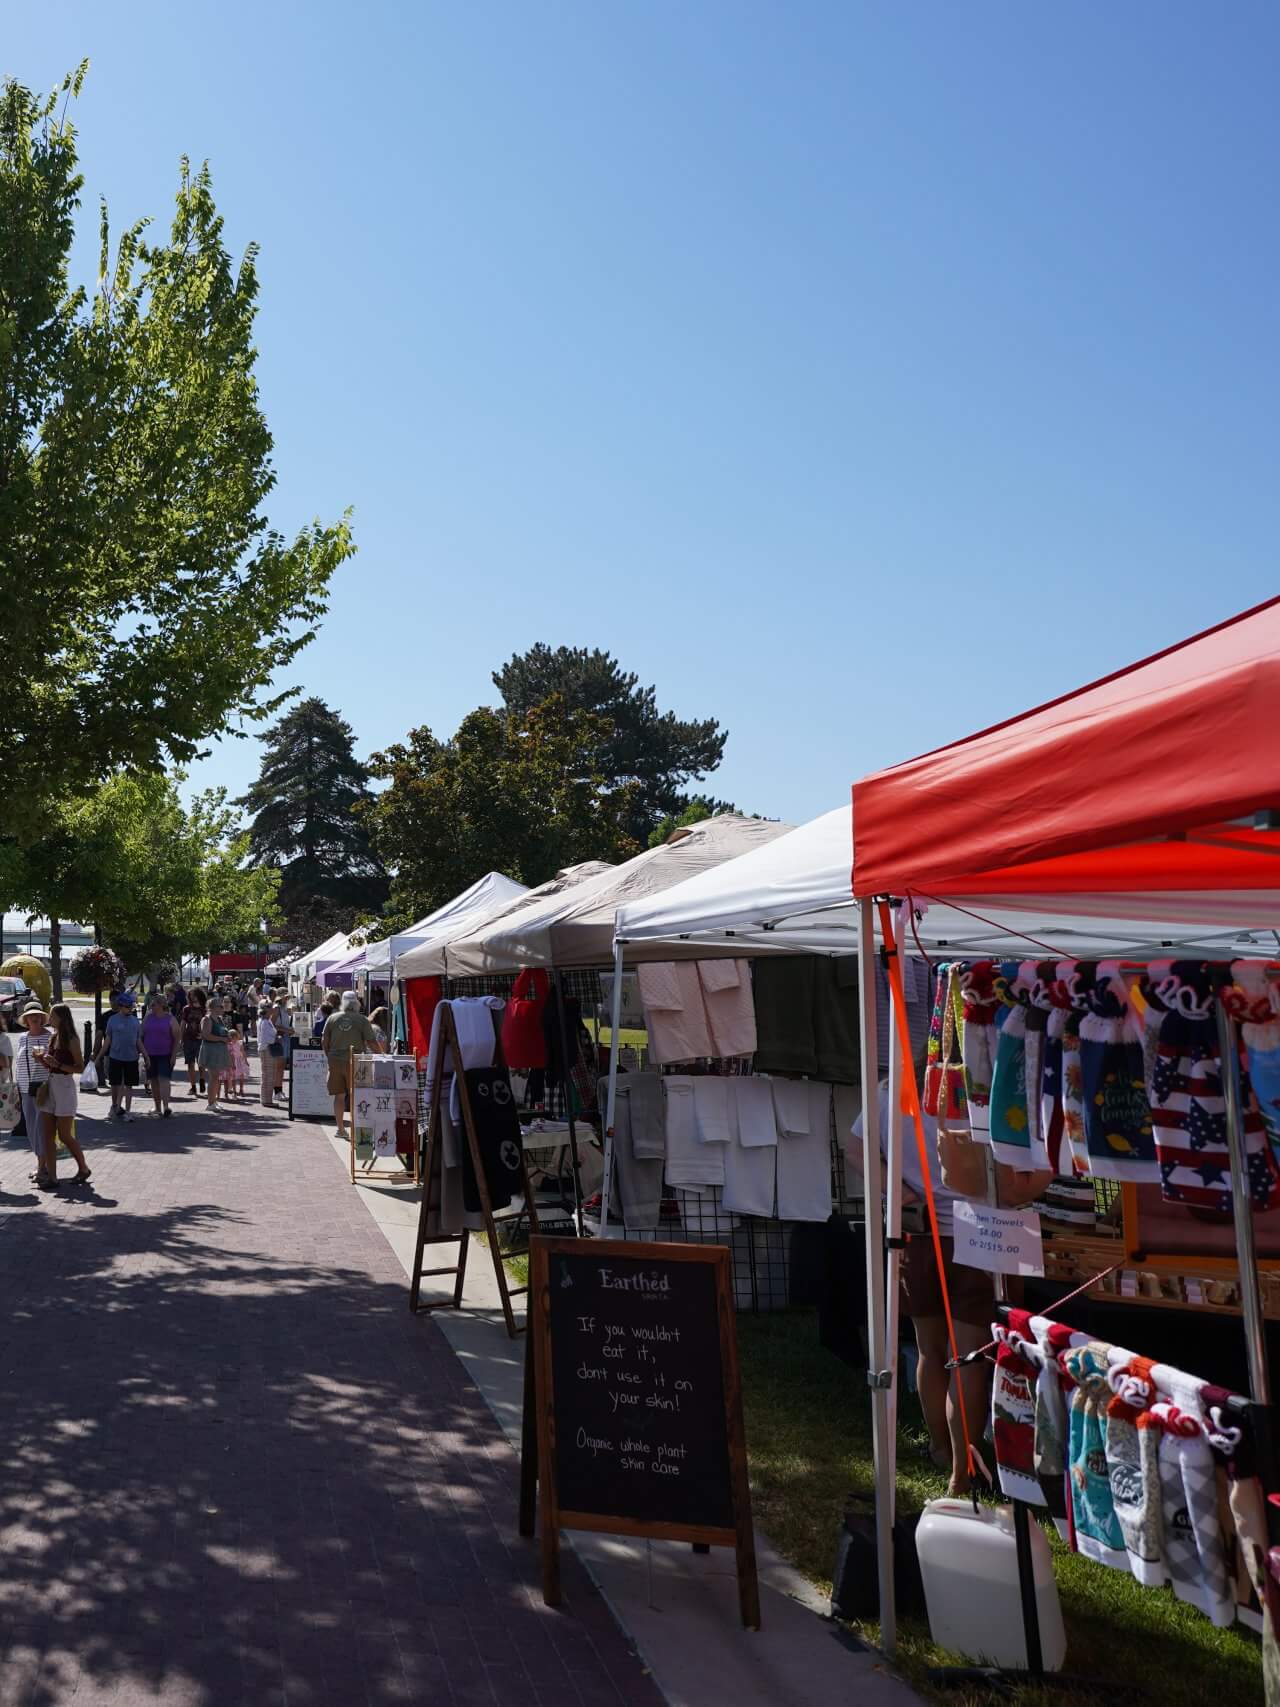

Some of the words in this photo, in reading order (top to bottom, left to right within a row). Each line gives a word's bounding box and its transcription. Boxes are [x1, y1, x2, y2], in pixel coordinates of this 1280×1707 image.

[992, 1216, 1024, 1227] Towels
[969, 1239, 978, 1247] Or
[979, 1228, 1002, 1239] $8.00
[576, 1316, 596, 1332] If
[604, 1324, 626, 1343] you
[602, 1345, 626, 1360] eat
[617, 1371, 643, 1384] use
[654, 1371, 666, 1387] it
[674, 1378, 694, 1391] on
[608, 1391, 640, 1414] your
[645, 1394, 681, 1412] skin!
[576, 1426, 614, 1457] Organic
[620, 1436, 651, 1454] whole
[657, 1442, 688, 1463] plant
[620, 1457, 645, 1471] skin
[652, 1462, 680, 1476] care
